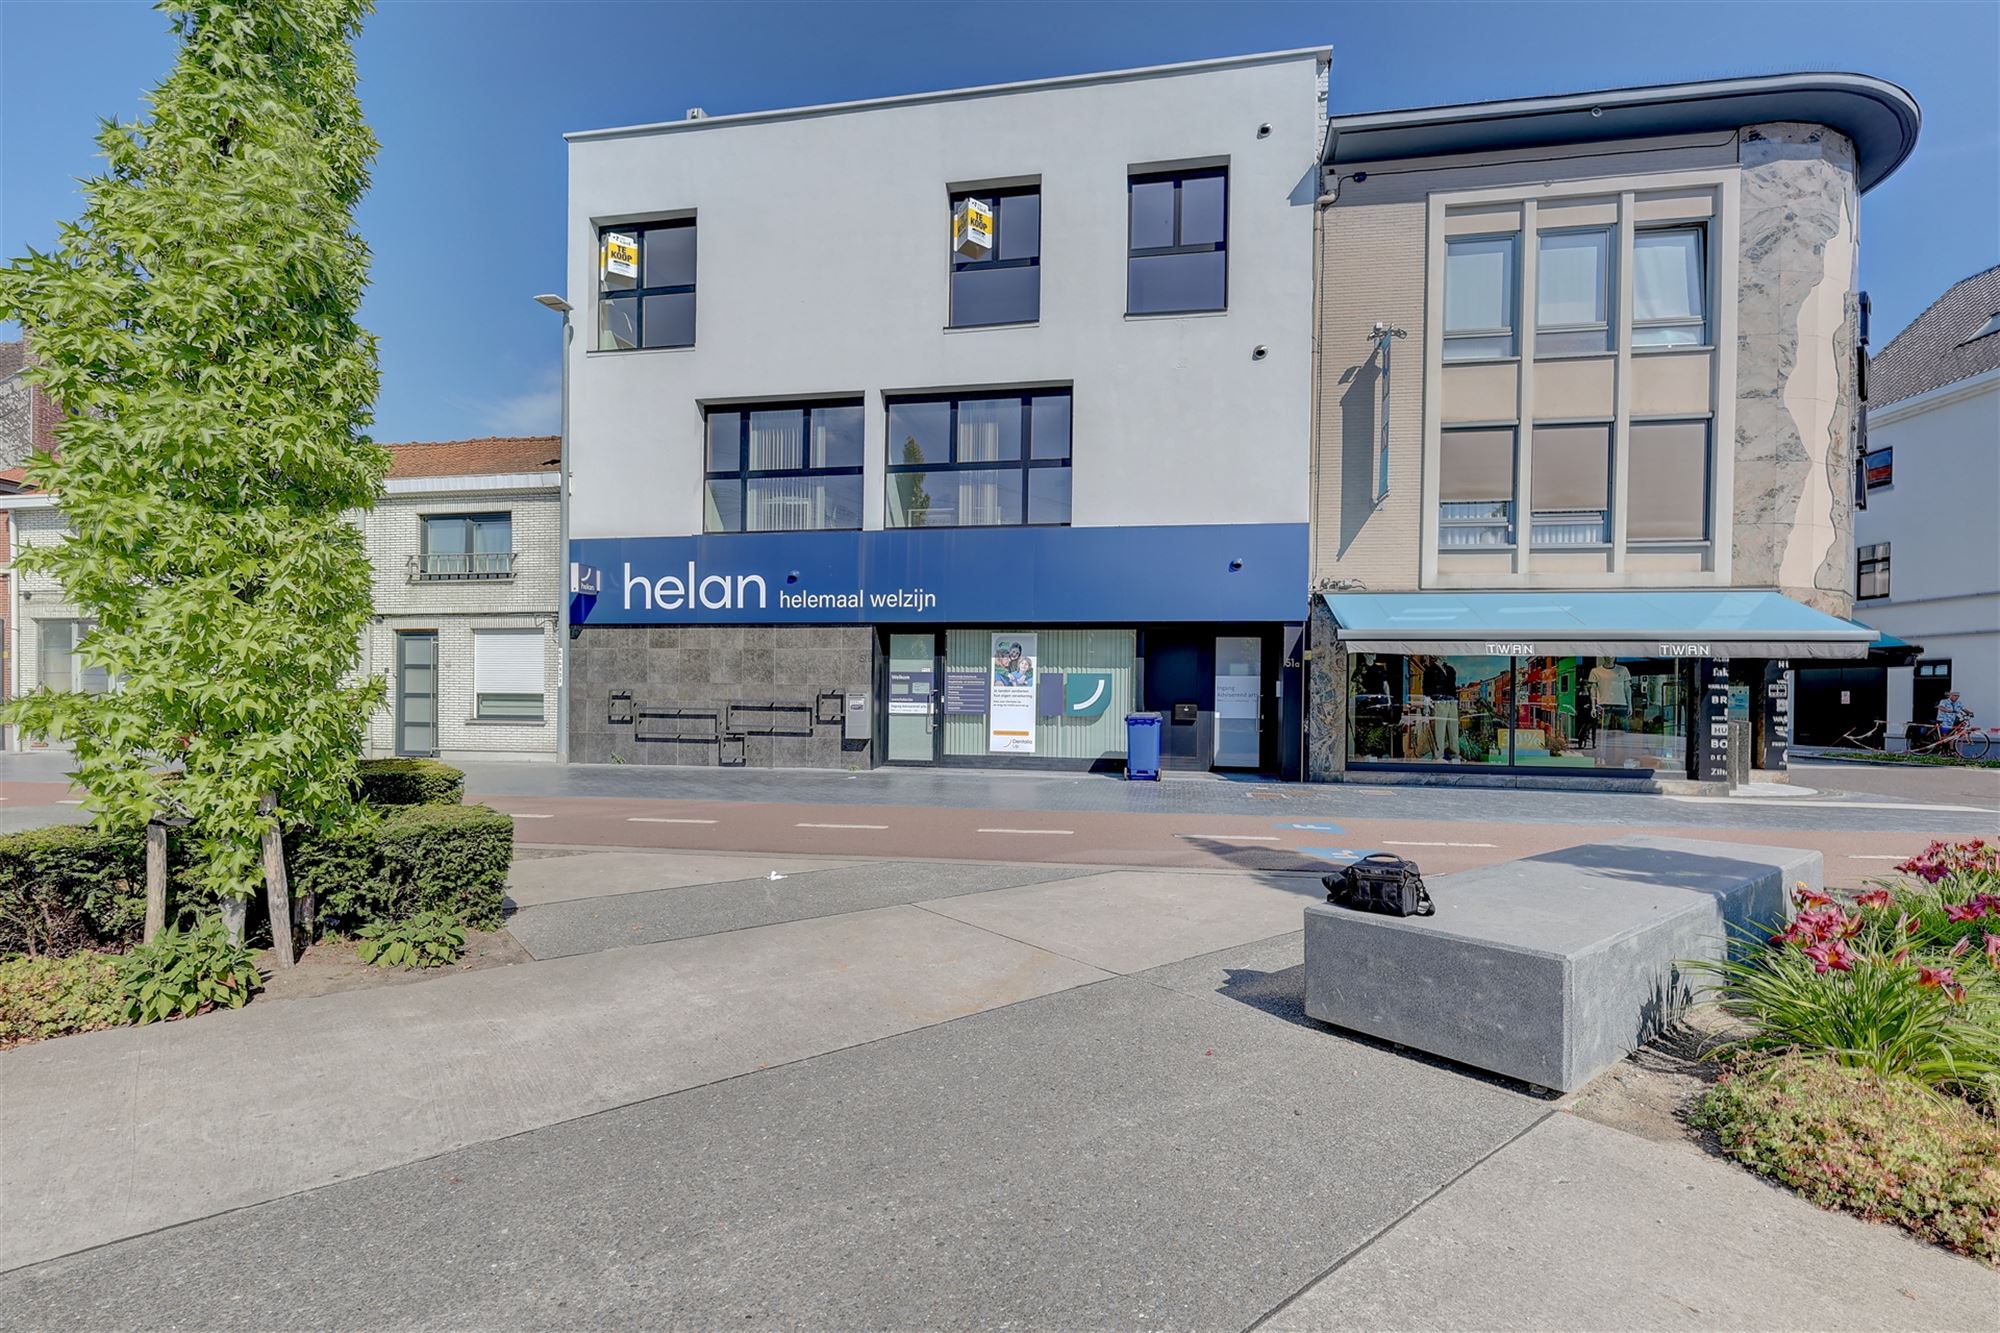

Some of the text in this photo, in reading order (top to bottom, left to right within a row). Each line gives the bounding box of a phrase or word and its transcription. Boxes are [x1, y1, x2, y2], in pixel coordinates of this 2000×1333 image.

[975, 211, 983, 221] TE
[970, 217, 988, 231] KOOP
[617, 245, 627, 253] TE
[610, 250, 633, 262] KOOP
[580, 583, 595, 592] helan
[624, 561, 766, 610] helan
[779, 588, 936, 612] helemaal welzijn
[1486, 643, 1534, 655] TWAN
[1660, 644, 1709, 656] TWAN
[1285, 658, 1301, 668] 51a
[1711, 695, 1728, 705] BR
[1711, 739, 1728, 748] BO
